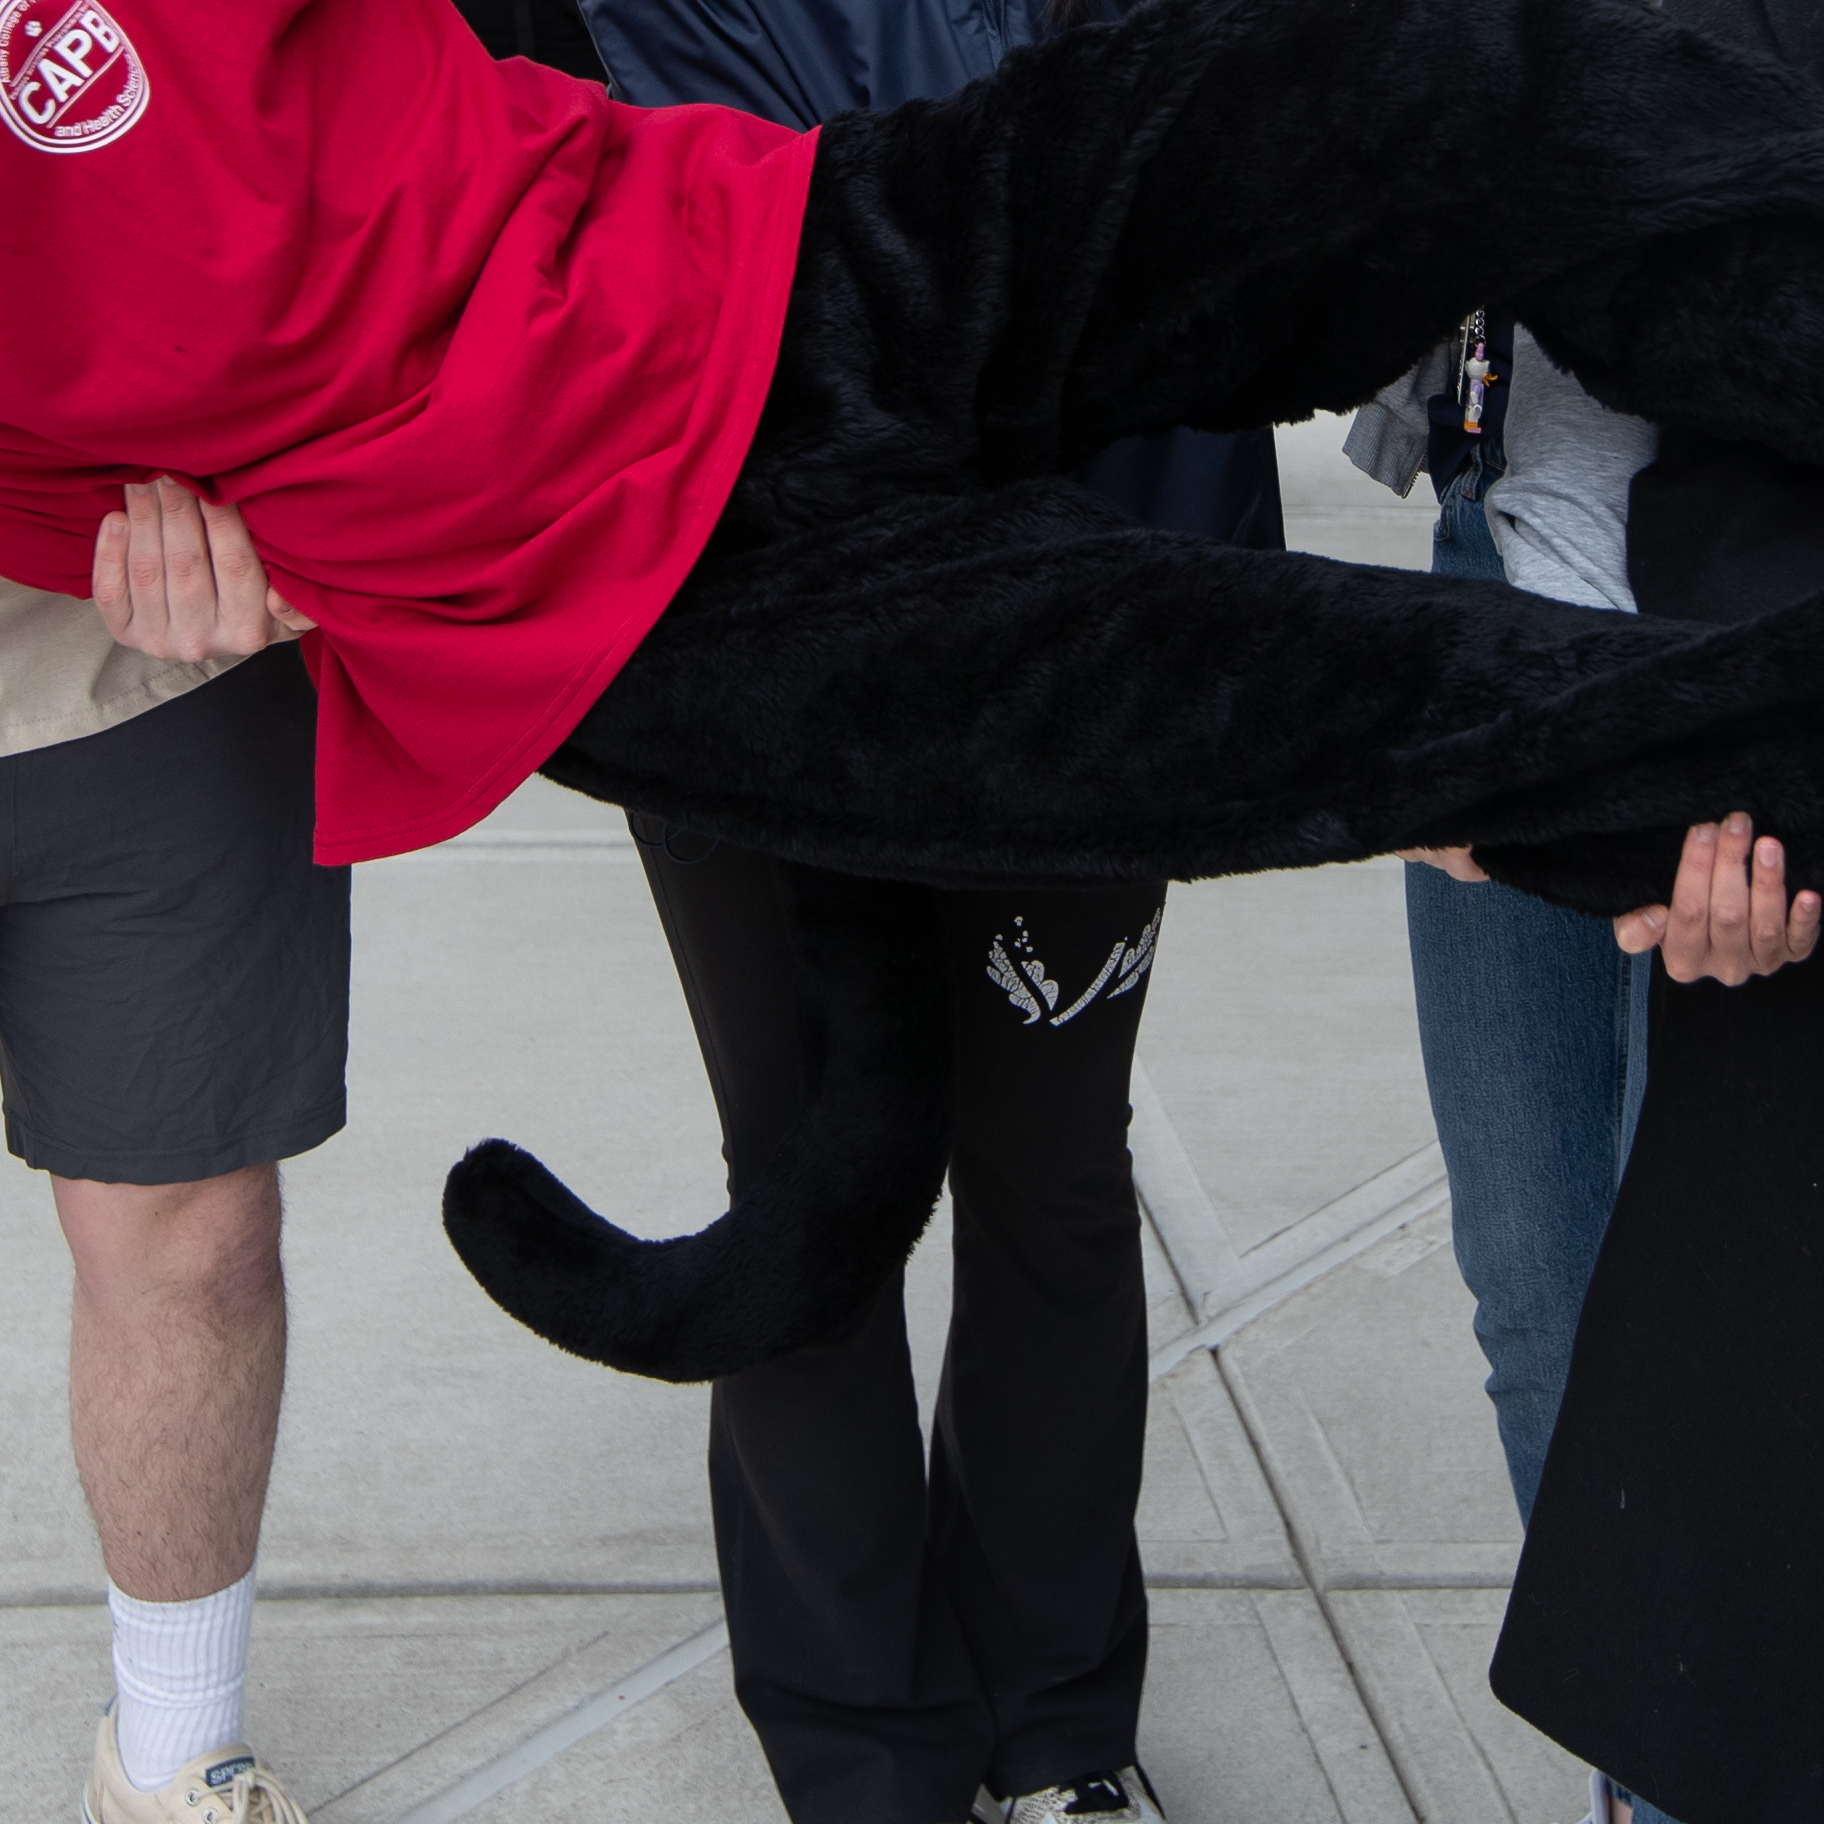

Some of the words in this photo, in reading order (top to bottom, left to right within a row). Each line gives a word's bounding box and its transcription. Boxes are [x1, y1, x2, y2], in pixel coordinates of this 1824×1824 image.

[17, 0, 31, 14] of
[18, 9, 120, 125] CAPB
[54, 123, 83, 137] and
[82, 103, 126, 135] Health
